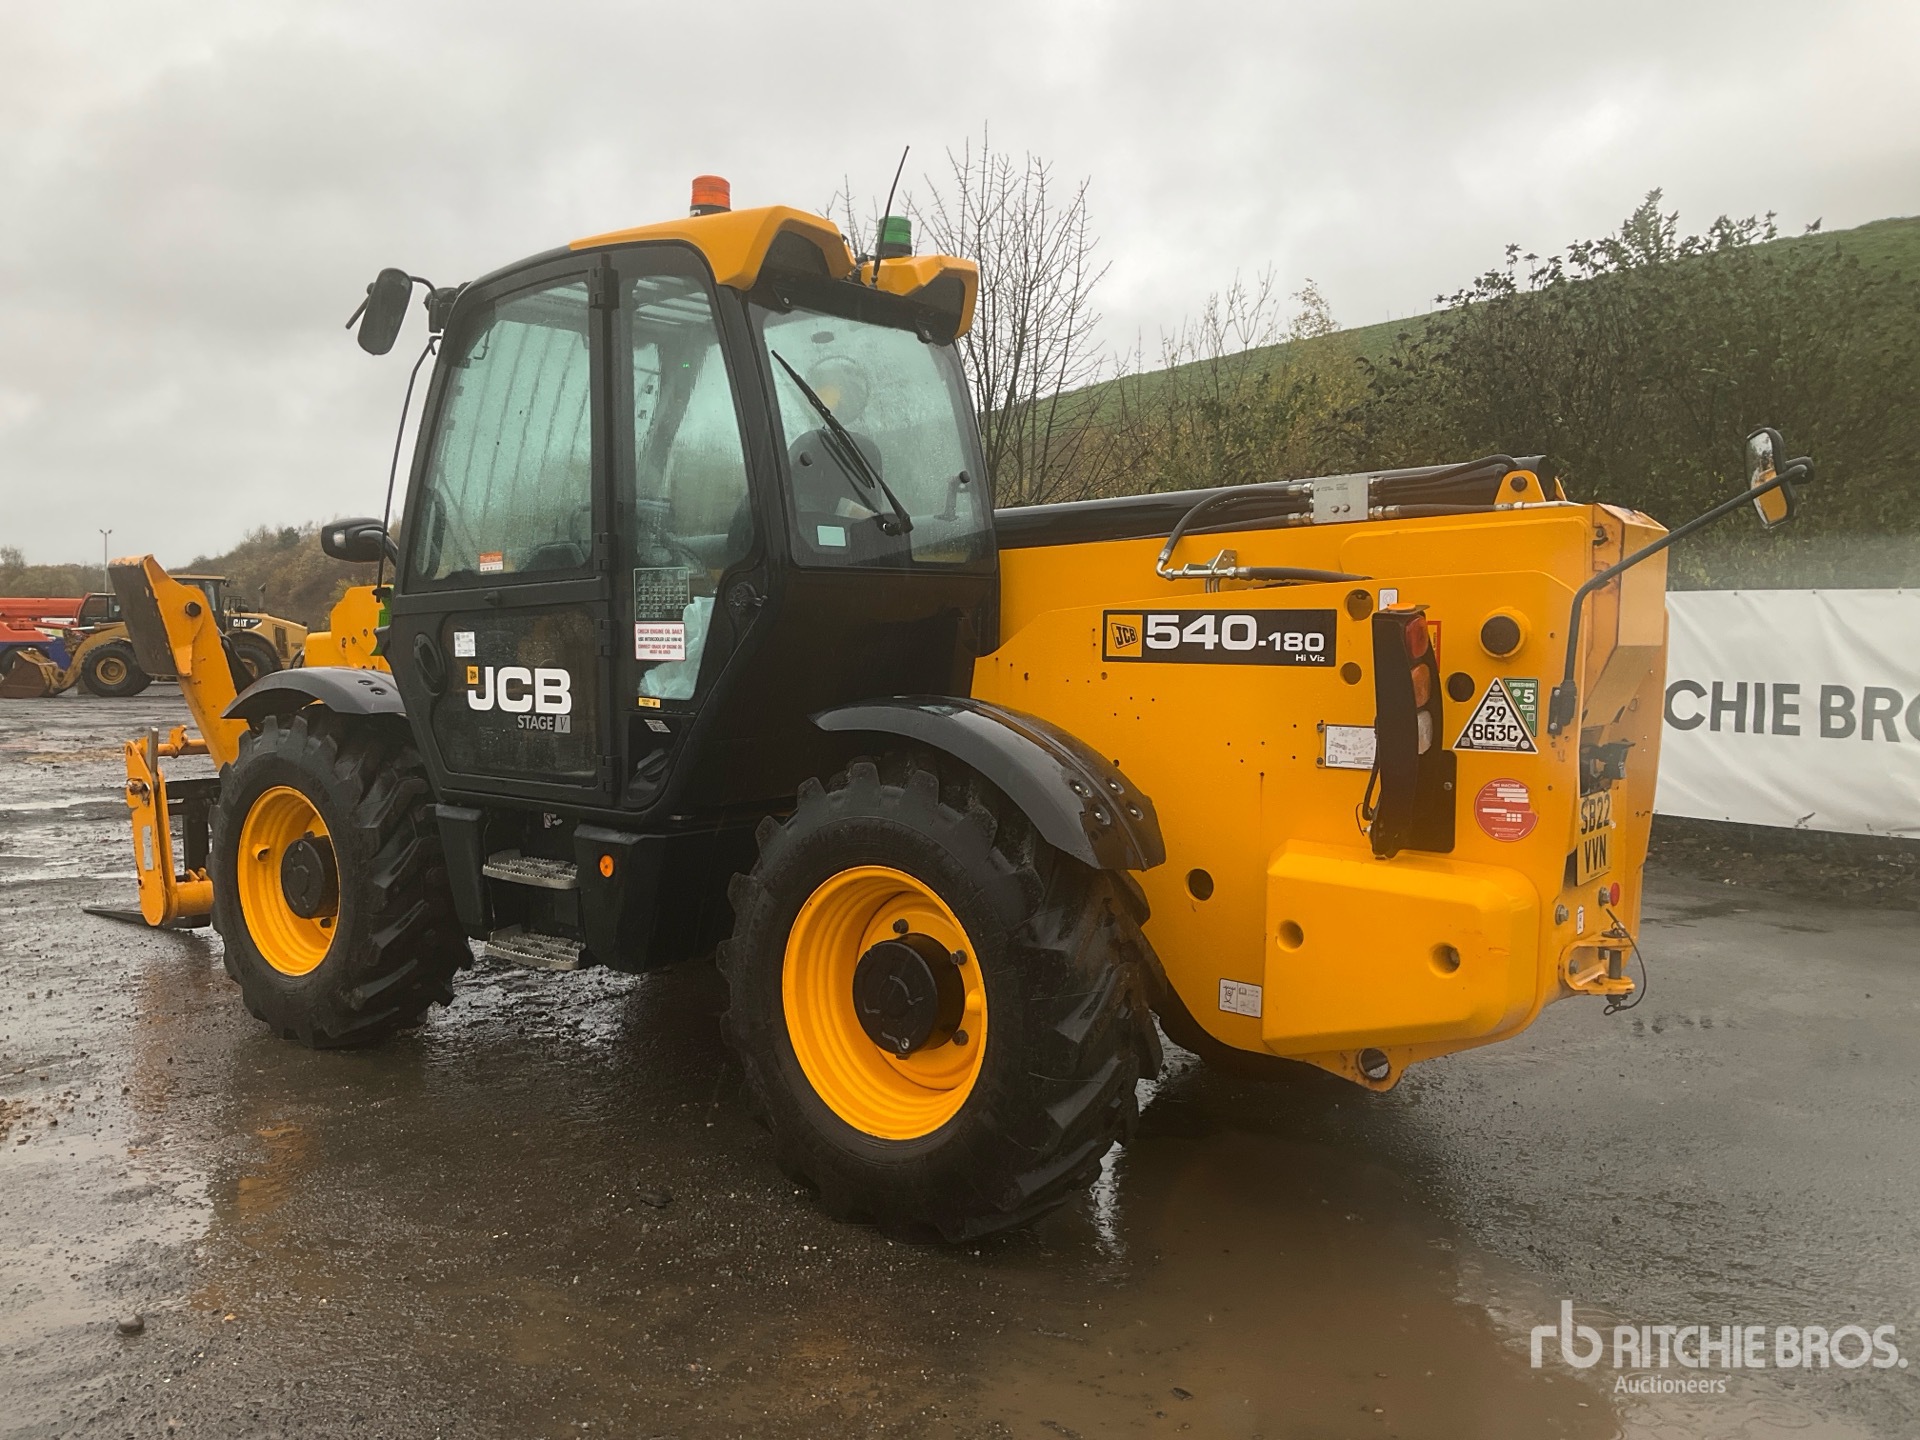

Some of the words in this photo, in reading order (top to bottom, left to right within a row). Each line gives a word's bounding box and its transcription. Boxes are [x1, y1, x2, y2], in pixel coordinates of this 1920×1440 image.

[232, 618, 249, 628] CAT
[1114, 625, 1137, 646] JCB
[1146, 614, 1325, 652] 540-180
[1295, 654, 1307, 662] Hi
[1310, 654, 1326, 663] Viz
[467, 666, 572, 715] JCB
[1523, 689, 1535, 703] 5
[1485, 705, 1507, 723] 29
[1664, 680, 1801, 737] CHIE
[517, 715, 554, 731] STAGE
[1472, 723, 1519, 742] BG3C
[1580, 794, 1611, 835] SB22
[1584, 833, 1607, 874] VVN
